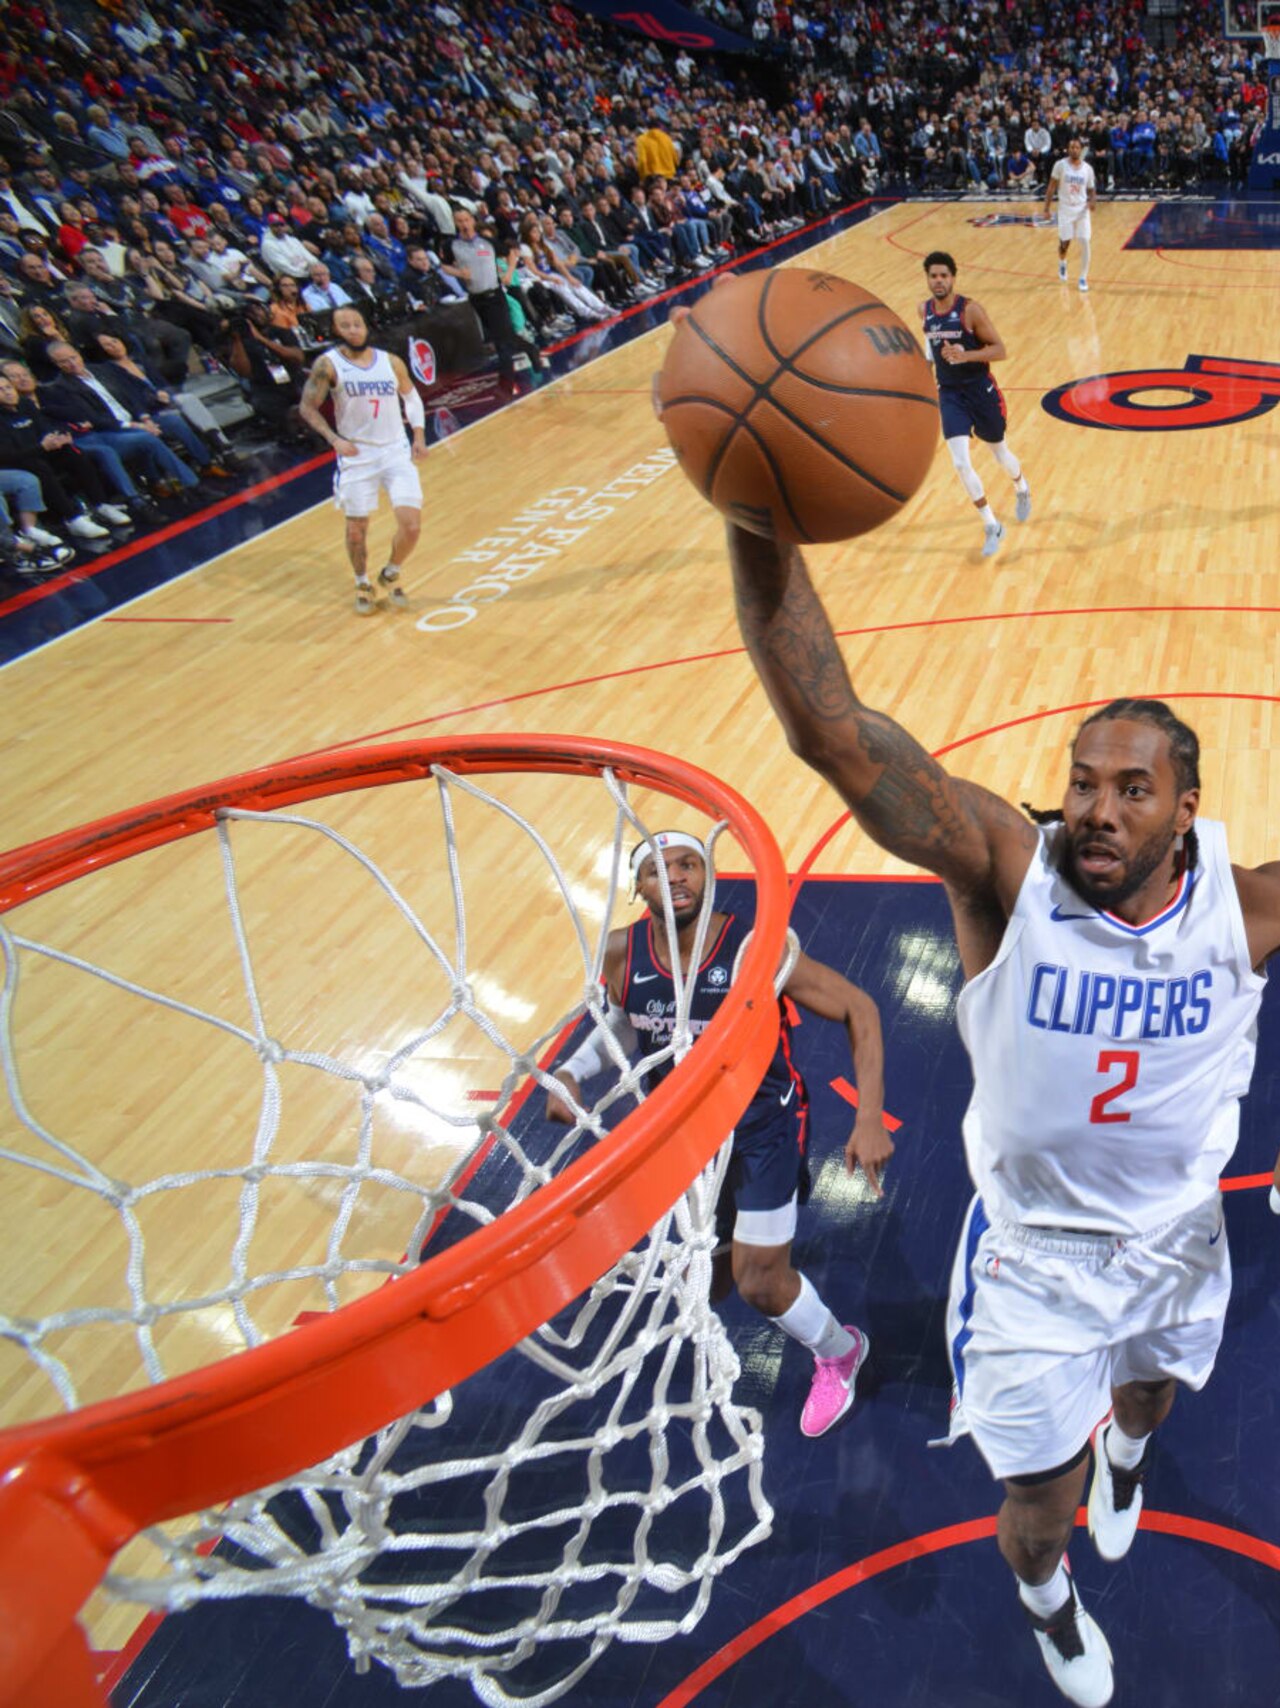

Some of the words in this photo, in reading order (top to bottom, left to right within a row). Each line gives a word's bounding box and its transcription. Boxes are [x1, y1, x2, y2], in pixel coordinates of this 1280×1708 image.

[344, 381, 395, 397] CLIPPERS
[369, 398, 379, 420] 7
[564, 446, 681, 521] WELLS
[450, 485, 588, 563] CENTER
[415, 525, 591, 632] FARGO
[1027, 961, 1213, 1039] CLIPPERS
[1090, 1051, 1140, 1124] 2
